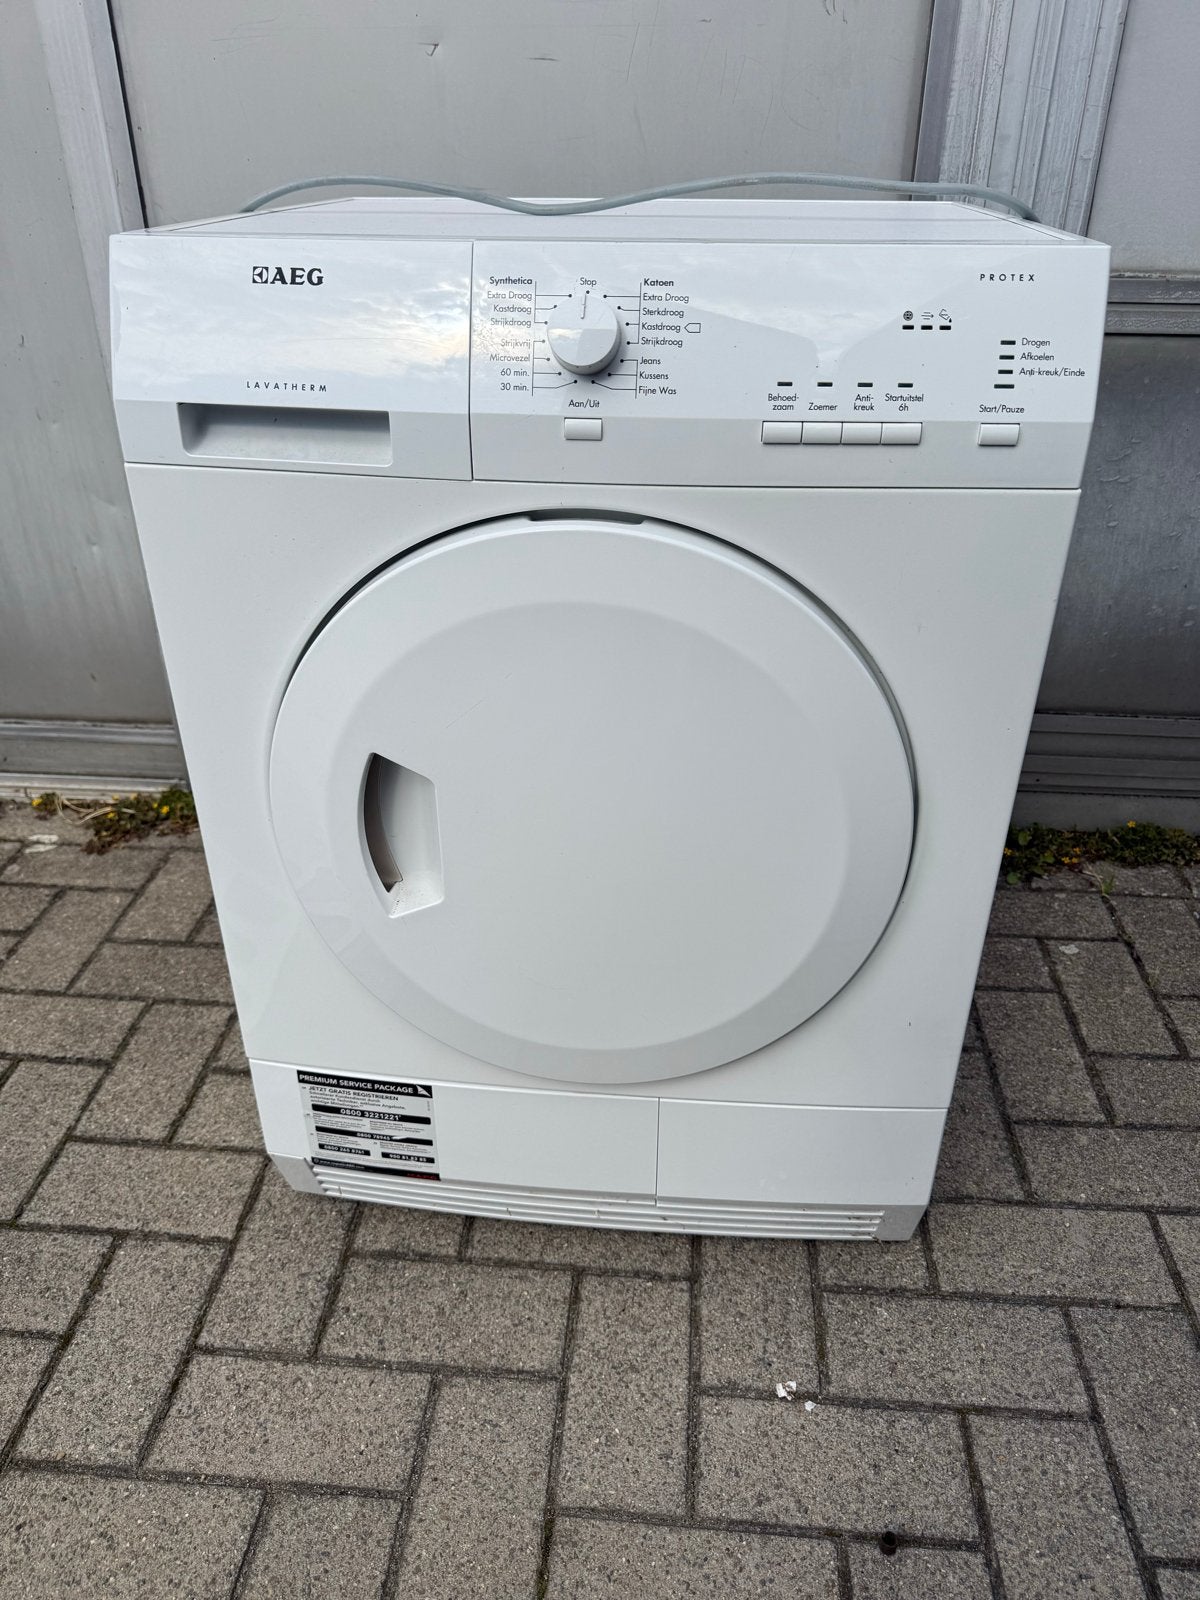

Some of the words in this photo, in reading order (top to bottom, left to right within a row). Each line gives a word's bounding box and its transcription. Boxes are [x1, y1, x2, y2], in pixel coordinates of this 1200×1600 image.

[270, 267, 324, 286] AEG
[490, 276, 532, 286] Synthetica
[979, 273, 1035, 282] PROTEX
[580, 277, 597, 286] Stop
[643, 279, 674, 287] Katoen
[487, 291, 507, 300] Extra
[508, 291, 532, 301] Droog
[643, 293, 662, 301] Extra
[664, 294, 689, 303] Droog
[493, 304, 532, 314] Kastdroog
[642, 308, 684, 318] Sterkdroog
[490, 318, 532, 328] Strijkdroog
[641, 323, 681, 333] Kastdroog
[501, 339, 531, 348] Strijkvrij
[641, 337, 683, 347] Strijkdroog
[1021, 338, 1050, 348] Drogen
[490, 354, 531, 362] Microvezel
[640, 357, 661, 365] Jeans
[1020, 353, 1055, 361] Afkoelen
[500, 369, 511, 377] 60
[513, 369, 530, 377] min.
[639, 371, 669, 380] Kussens
[1019, 367, 1085, 377] Anti-kreuk/Einde
[247, 381, 327, 392] LAVATHERM
[500, 383, 511, 391] 30
[513, 383, 529, 391] min.
[638, 386, 658, 396] Fijne
[659, 386, 677, 395] Was
[768, 393, 799, 401] Behoed-
[855, 394, 874, 402] Anti-
[885, 393, 924, 402] Startuitstel
[568, 399, 600, 409] Aan/Uit
[808, 403, 837, 411] Zoemer
[854, 403, 874, 411] kreuk
[898, 403, 908, 411] 6h
[979, 404, 1025, 413] Start/Pauze
[299, 1074, 337, 1085] PREMIUM
[339, 1080, 373, 1089] SERVICE
[374, 1083, 413, 1093] PACKAGE
[328, 1088, 352, 1096] GRATIS
[352, 1091, 399, 1101] REGISTRIEREN
[340, 1108, 361, 1116] 0800
